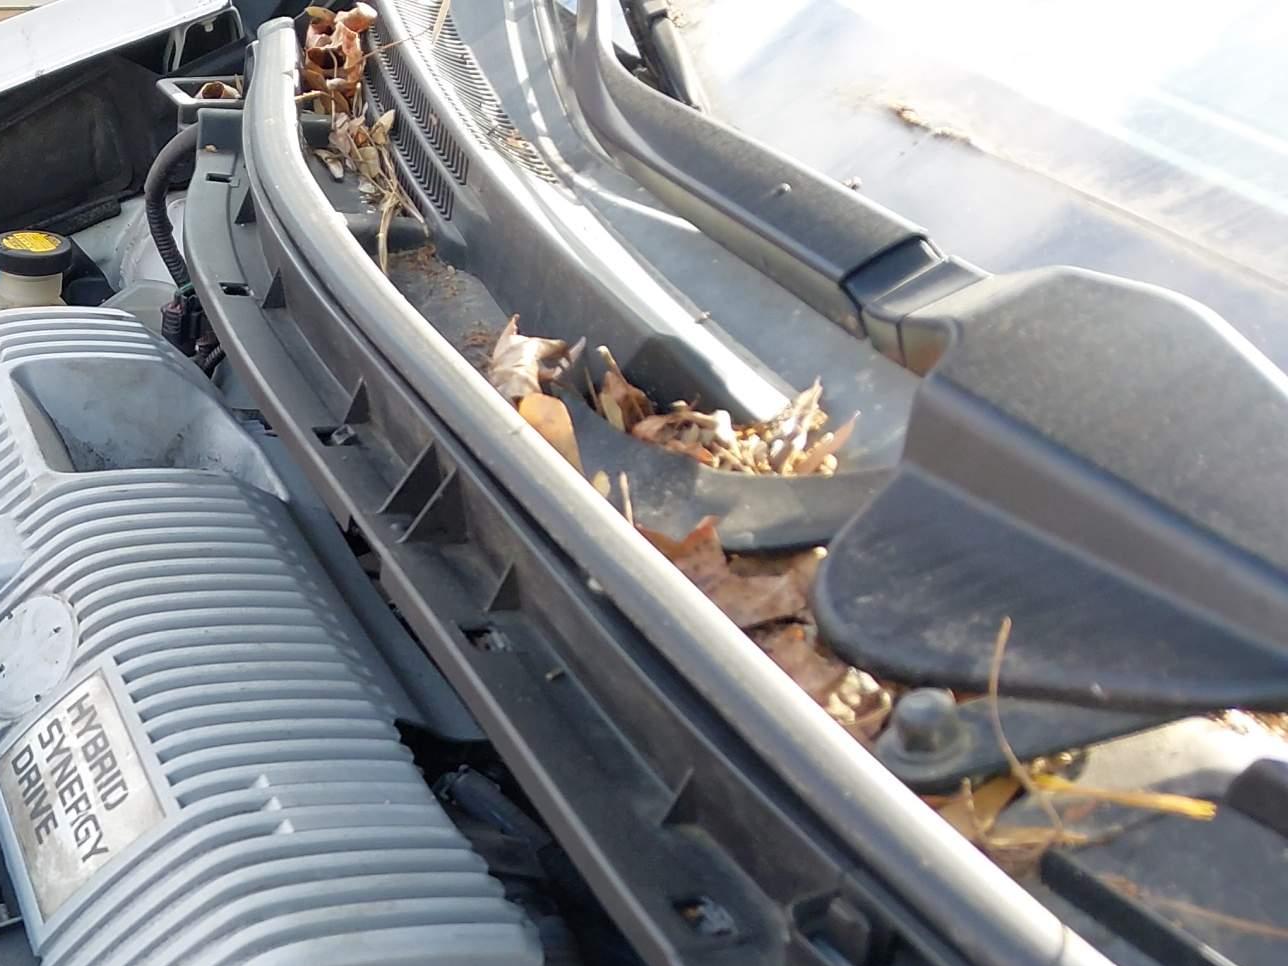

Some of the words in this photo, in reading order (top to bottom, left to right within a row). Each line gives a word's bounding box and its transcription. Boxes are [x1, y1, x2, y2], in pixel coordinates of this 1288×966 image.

[11, 744, 58, 845] DRIVE
[38, 718, 110, 864] SYNERGY
[66, 692, 129, 811] HYBRID
